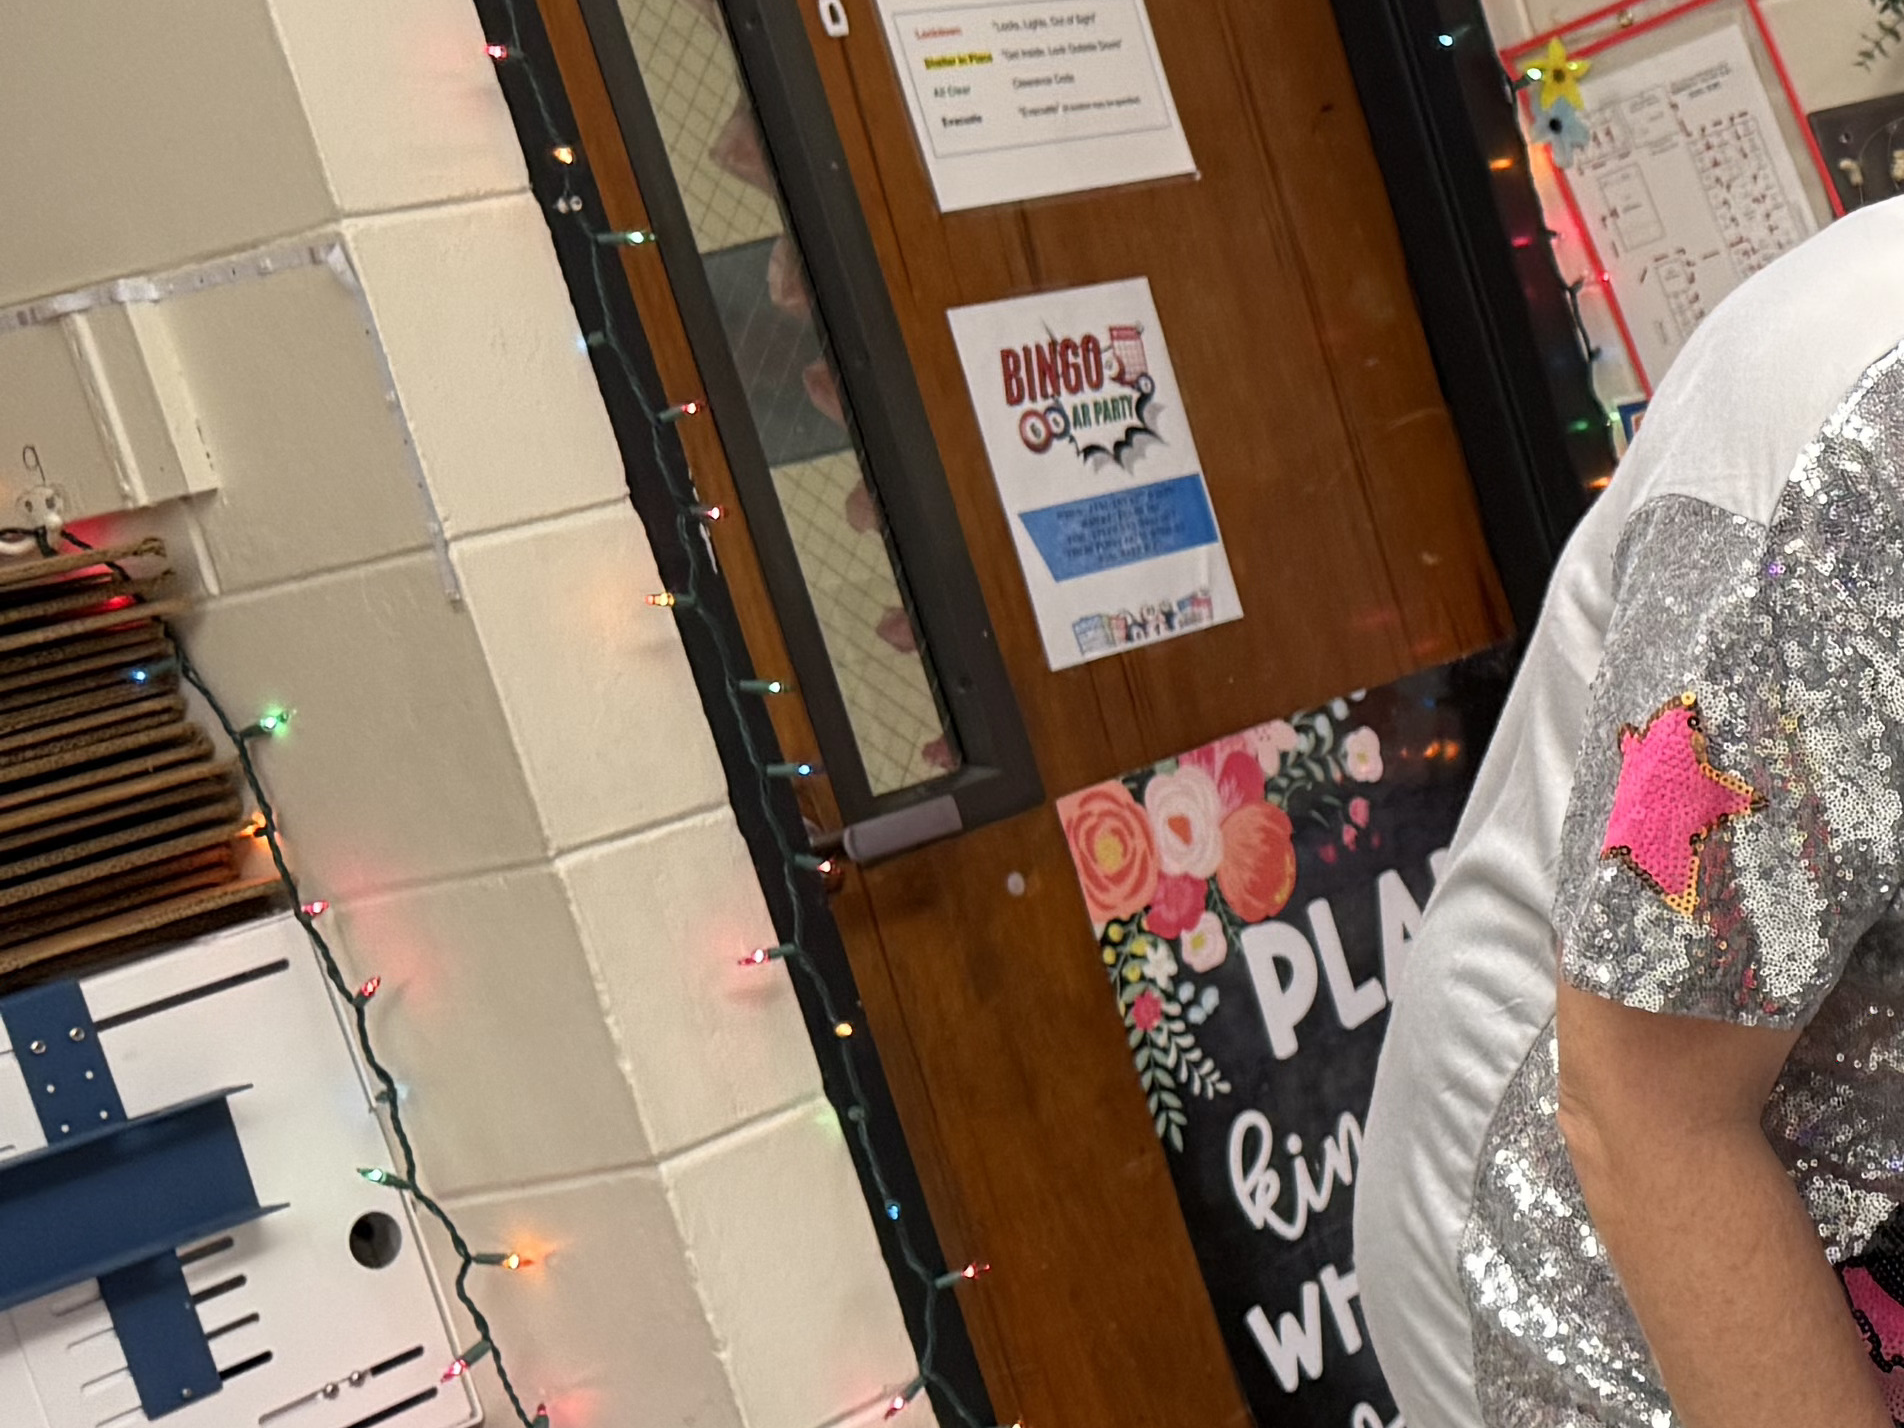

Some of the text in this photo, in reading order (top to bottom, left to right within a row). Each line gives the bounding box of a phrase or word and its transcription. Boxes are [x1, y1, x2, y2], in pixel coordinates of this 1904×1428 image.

[1000, 334, 1104, 407] BINGO
[1072, 395, 1133, 429] AR PARTY
[1241, 847, 1450, 1059] PLA
